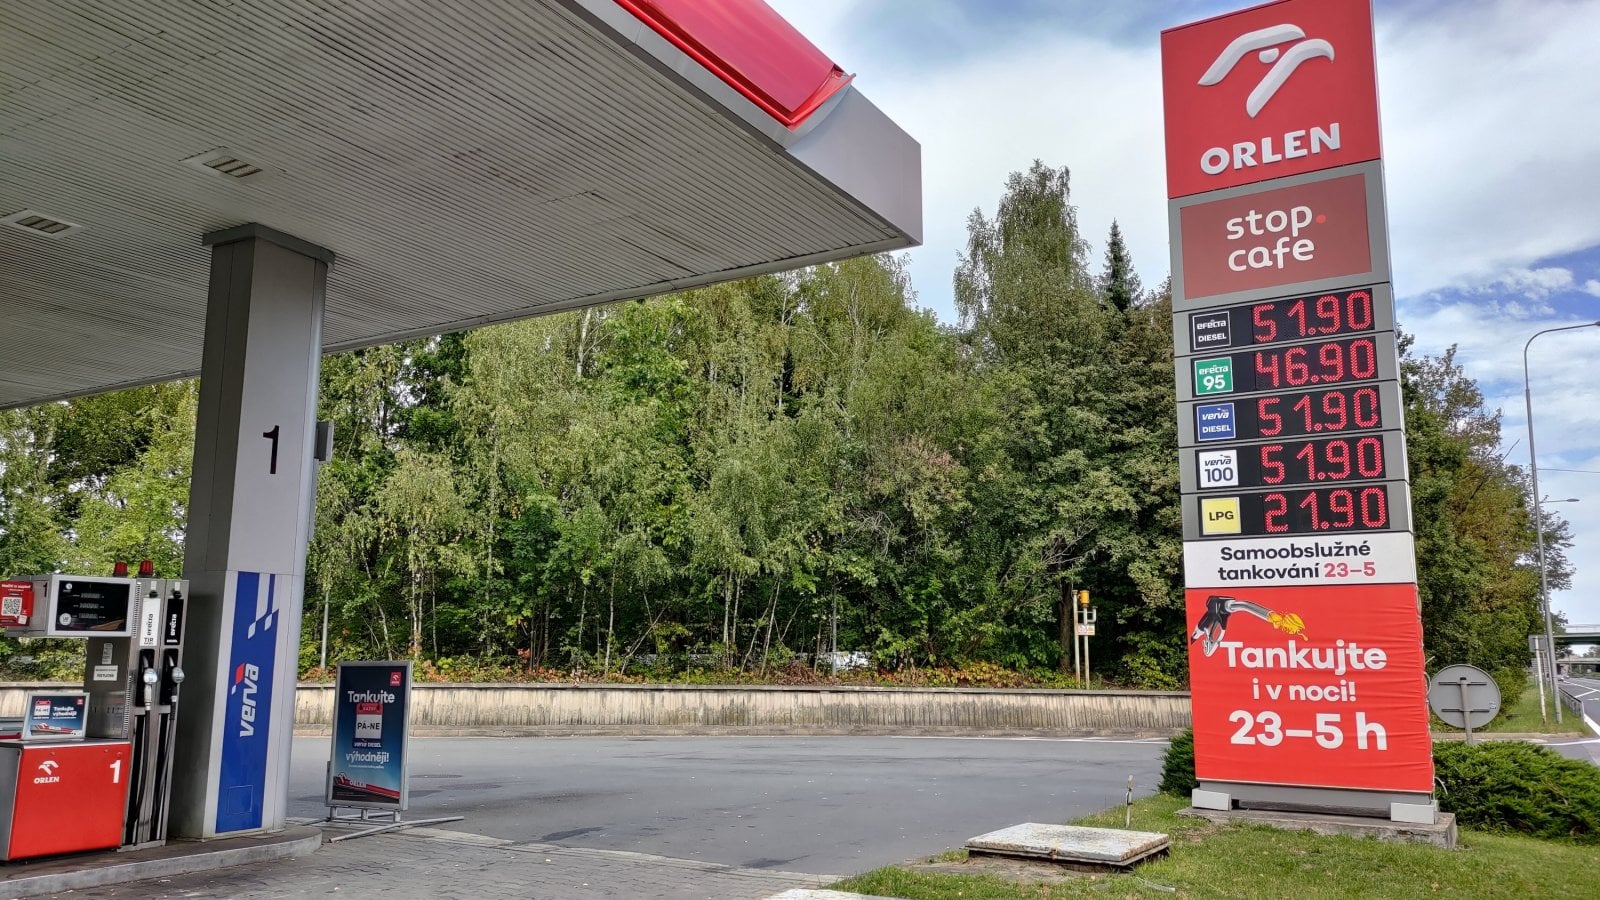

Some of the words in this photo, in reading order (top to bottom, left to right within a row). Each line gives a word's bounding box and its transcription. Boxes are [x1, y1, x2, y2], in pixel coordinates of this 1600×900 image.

[1200, 122, 1341, 175] ORLEN
[1228, 236, 1315, 272] cafe
[1253, 290, 1371, 342] 51.90
[1198, 332, 1227, 342] DIESEL
[1256, 339, 1376, 388] 46.90
[1203, 375, 1226, 390] 95
[1202, 409, 1230, 421] verva
[1258, 388, 1379, 436] 51.90
[1202, 424, 1231, 433] DIESEL
[262, 424, 280, 475] 1
[1204, 455, 1232, 466] verva
[1260, 437, 1383, 484] 51.90
[1204, 467, 1234, 483] 100
[1208, 510, 1234, 521] LPG
[1264, 487, 1387, 533] 21.90
[1220, 540, 1371, 561] Samoobslužné
[1218, 562, 1320, 580] tankování
[43, 582, 48, 598] 1
[1219, 639, 1388, 676] Tankujte
[239, 663, 260, 737] verva
[347, 689, 395, 704] Tankujte
[1252, 677, 1260, 700] i
[1265, 684, 1283, 700] v
[1289, 679, 1357, 702] noci!
[1355, 711, 1388, 751] h
[345, 750, 390, 764] výhodněji!
[33, 776, 60, 785] ORLEN
[109, 759, 121, 784] 1
